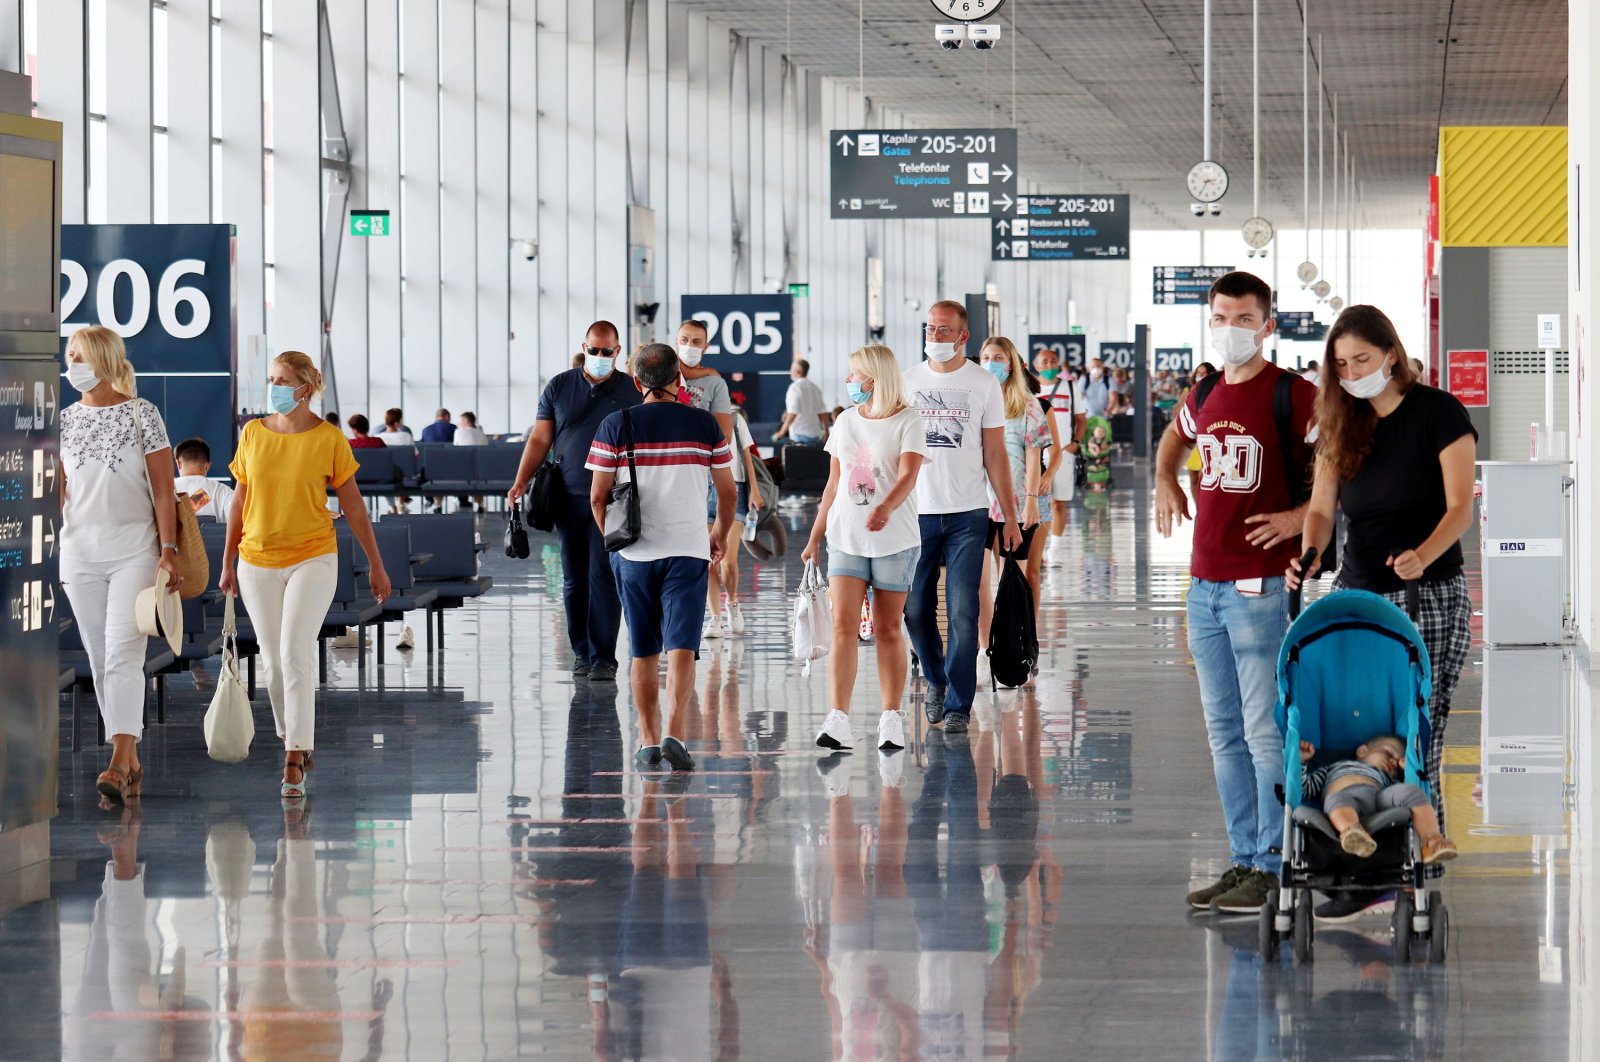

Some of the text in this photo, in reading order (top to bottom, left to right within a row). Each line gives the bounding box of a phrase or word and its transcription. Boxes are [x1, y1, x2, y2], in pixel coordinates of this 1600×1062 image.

[963, 3, 969, 11] 6
[882, 134, 996, 153] Kapılar 205-201
[882, 147, 912, 156] Gates
[898, 162, 950, 173] Telefonlar
[894, 176, 950, 186] Telephones
[932, 199, 951, 208] WC
[1058, 198, 1115, 213] 205-201
[1064, 219, 1071, 227] &
[1072, 218, 1090, 227] Kafe
[60, 258, 211, 339] 206
[691, 310, 783, 355] 205
[1157, 352, 1190, 370] 201
[1206, 420, 1247, 434] DONALD DUCK
[1500, 542, 1526, 551] TAV
